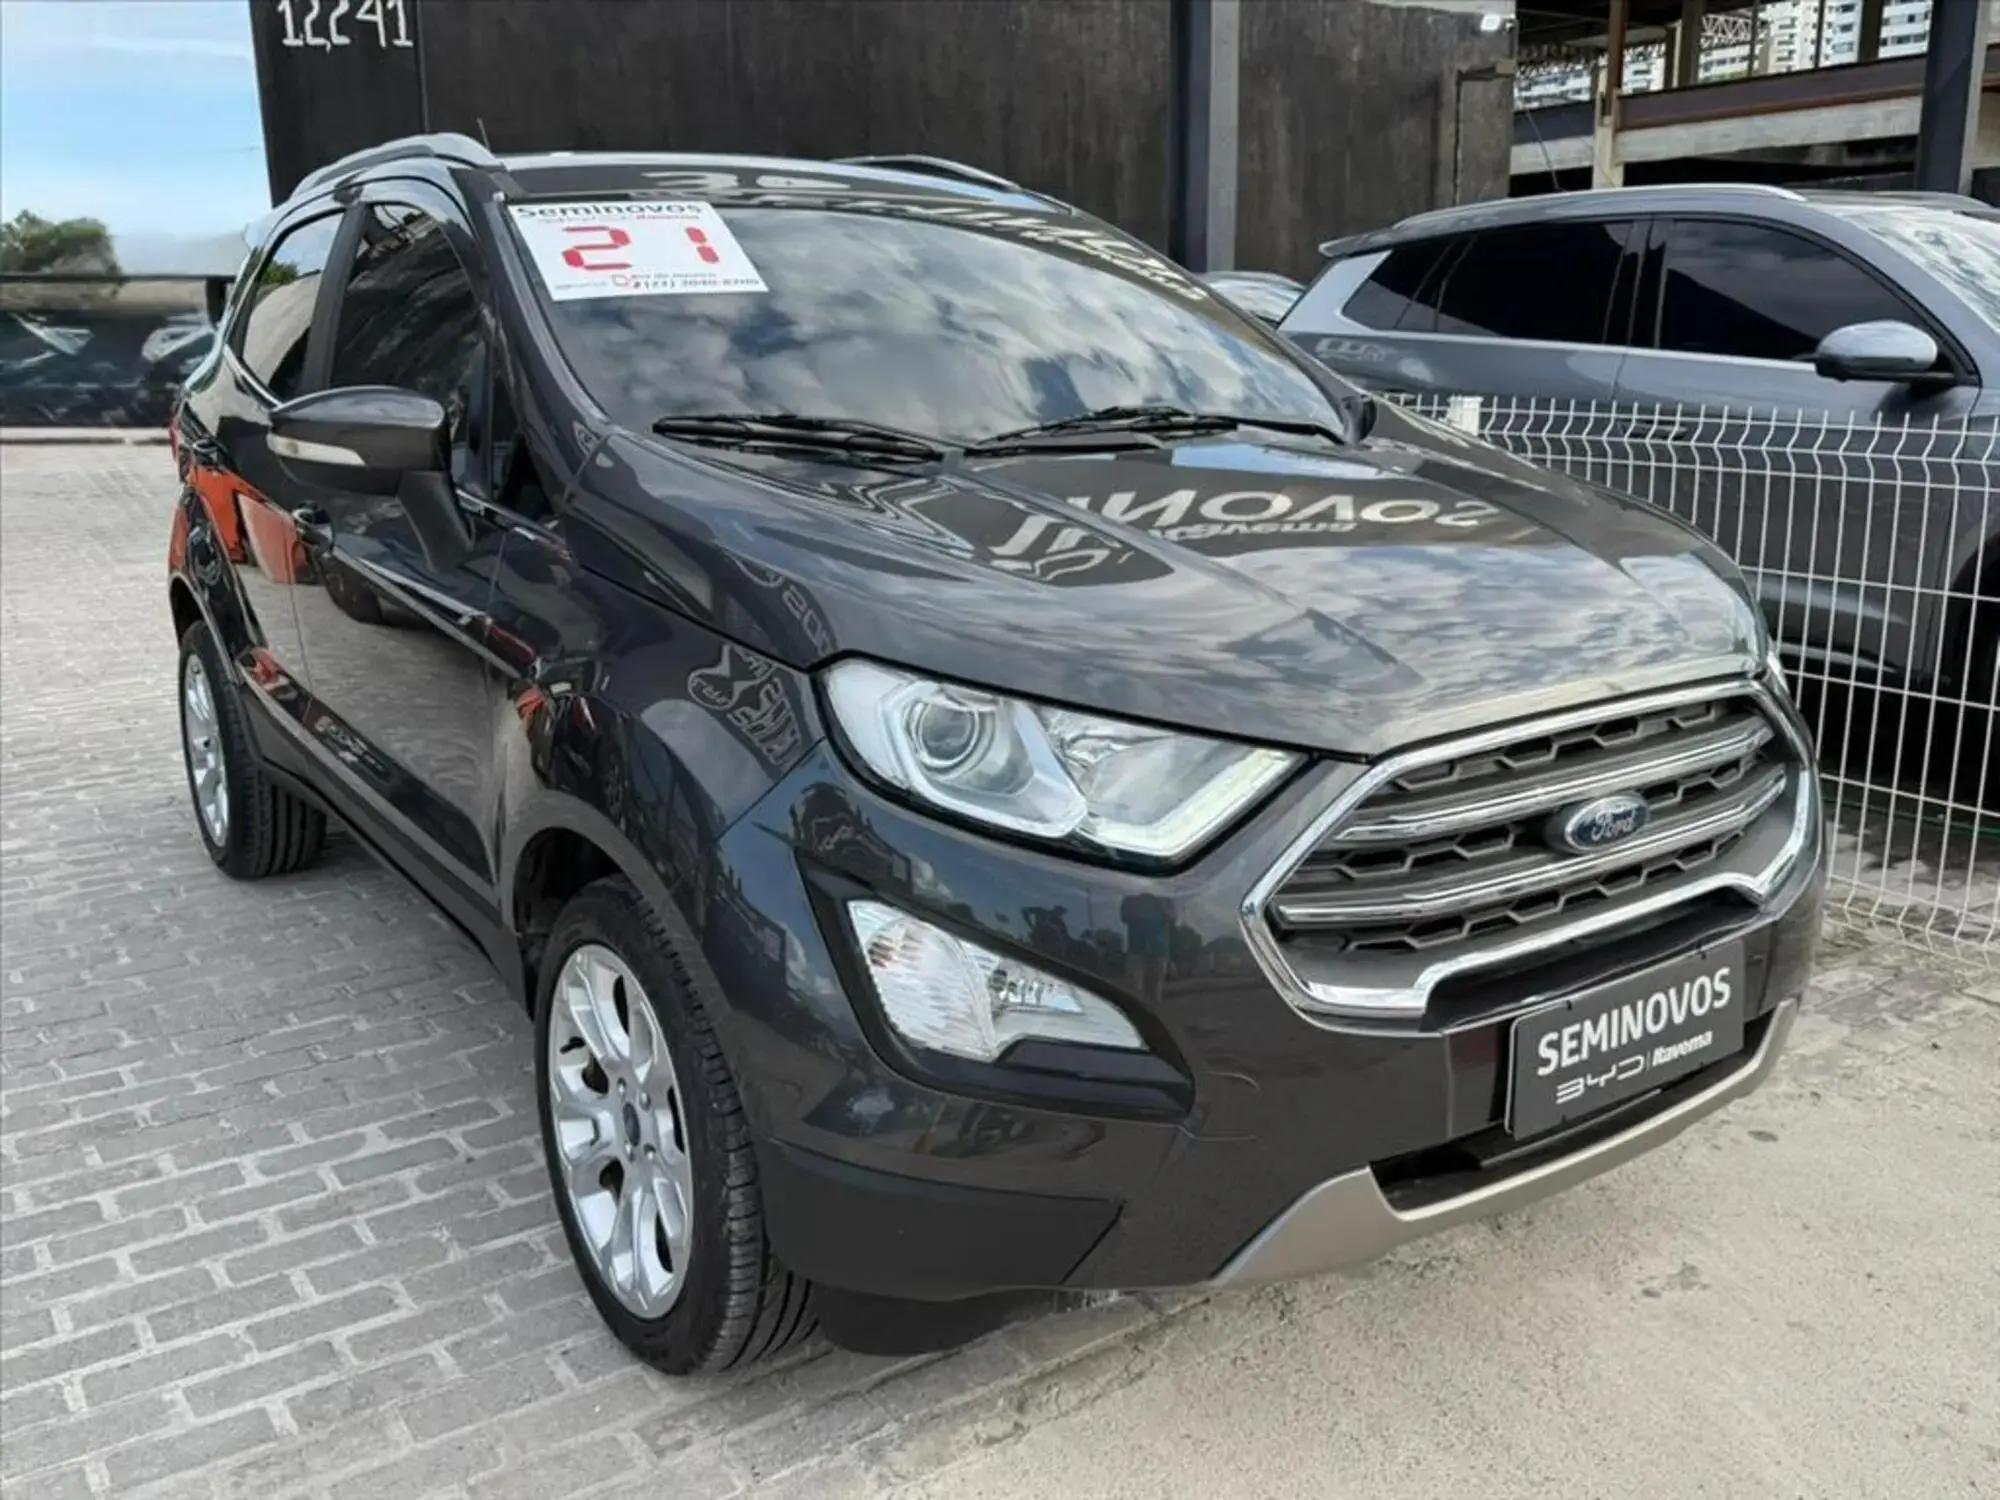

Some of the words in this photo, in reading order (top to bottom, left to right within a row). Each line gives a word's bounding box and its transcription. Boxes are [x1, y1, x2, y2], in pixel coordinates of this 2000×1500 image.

[517, 203, 702, 217] Seminovos
[562, 226, 719, 271] 21
[1590, 804, 1637, 841] Ford
[1537, 966, 1731, 1076] SEMINOVOS
[1556, 1055, 1645, 1104] BYD
